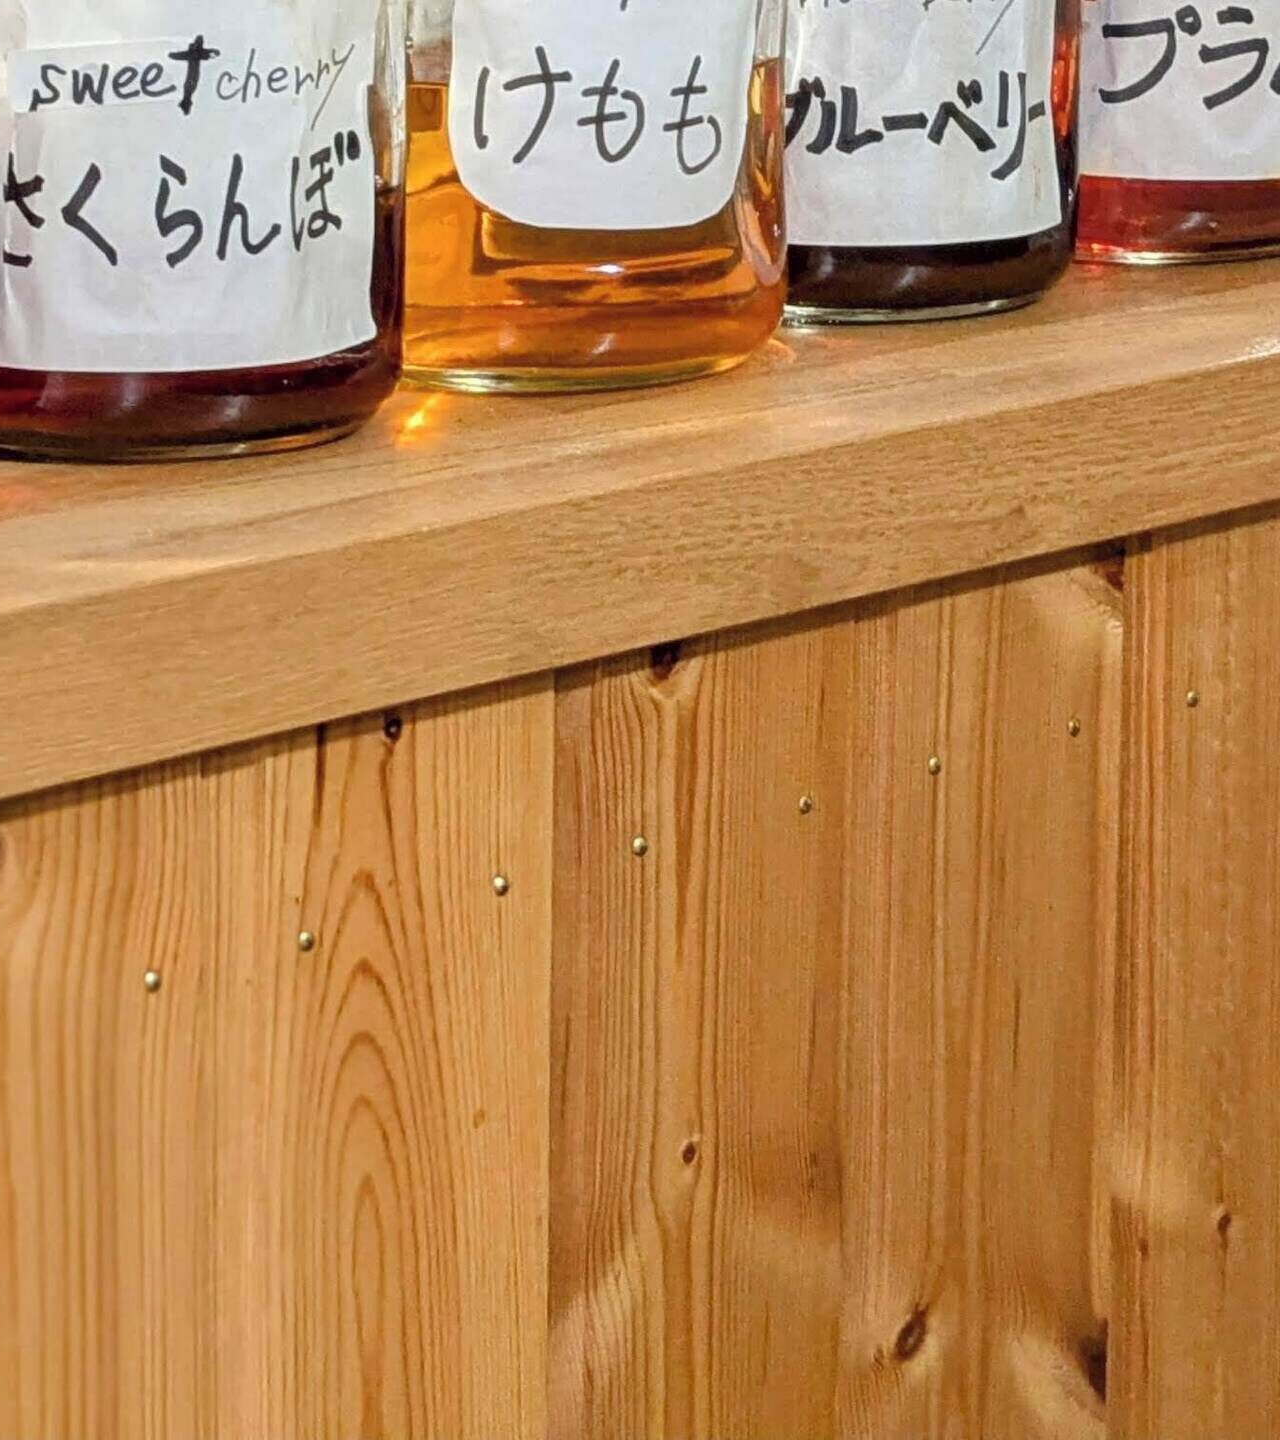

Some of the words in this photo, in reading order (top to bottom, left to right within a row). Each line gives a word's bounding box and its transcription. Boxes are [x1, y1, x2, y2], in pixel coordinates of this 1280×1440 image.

[28, 34, 220, 116] sweet
[216, 43, 355, 132] cherry
[473, 46, 723, 176] けもも
[2, 129, 362, 269] さくらんぼ
